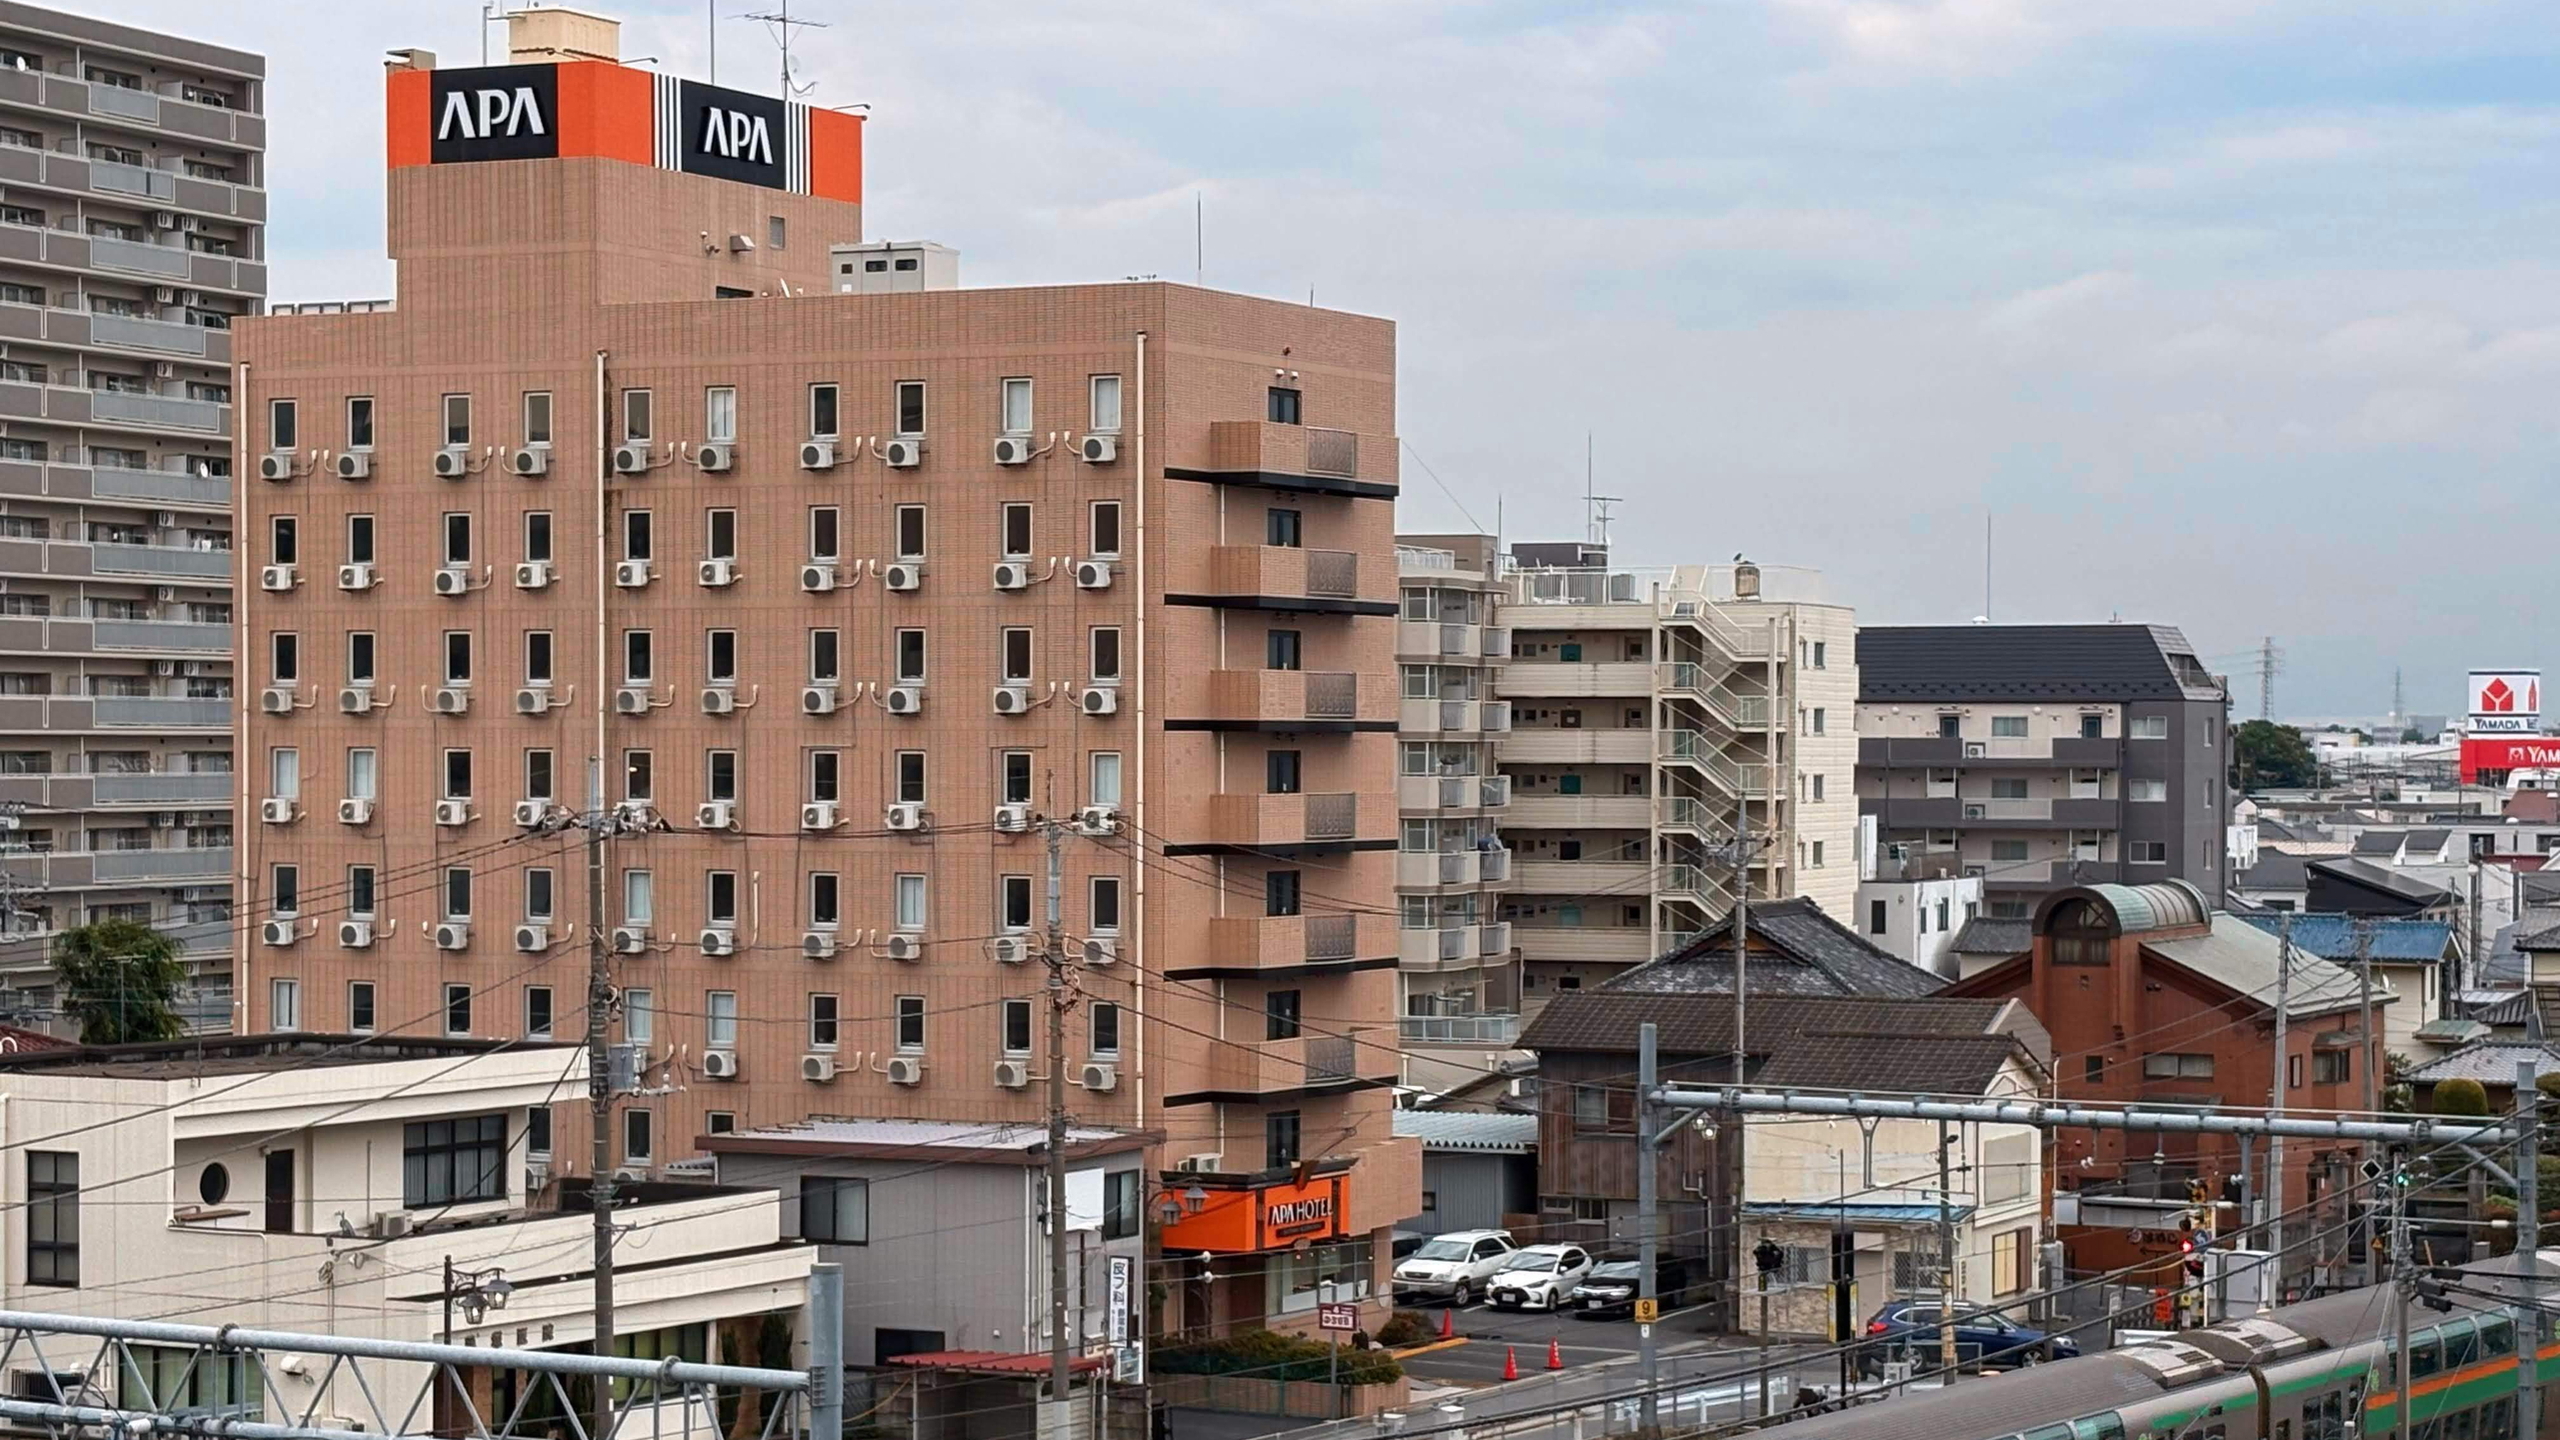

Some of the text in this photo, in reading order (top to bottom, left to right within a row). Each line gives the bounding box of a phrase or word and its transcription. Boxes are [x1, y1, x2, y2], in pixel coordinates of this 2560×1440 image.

[438, 87, 545, 140] APA
[704, 107, 774, 165] APA
[2474, 718, 2521, 730] YAMADA
[1271, 1197, 1334, 1226] APA HOTEL
[1641, 1300, 1651, 1315] 9
